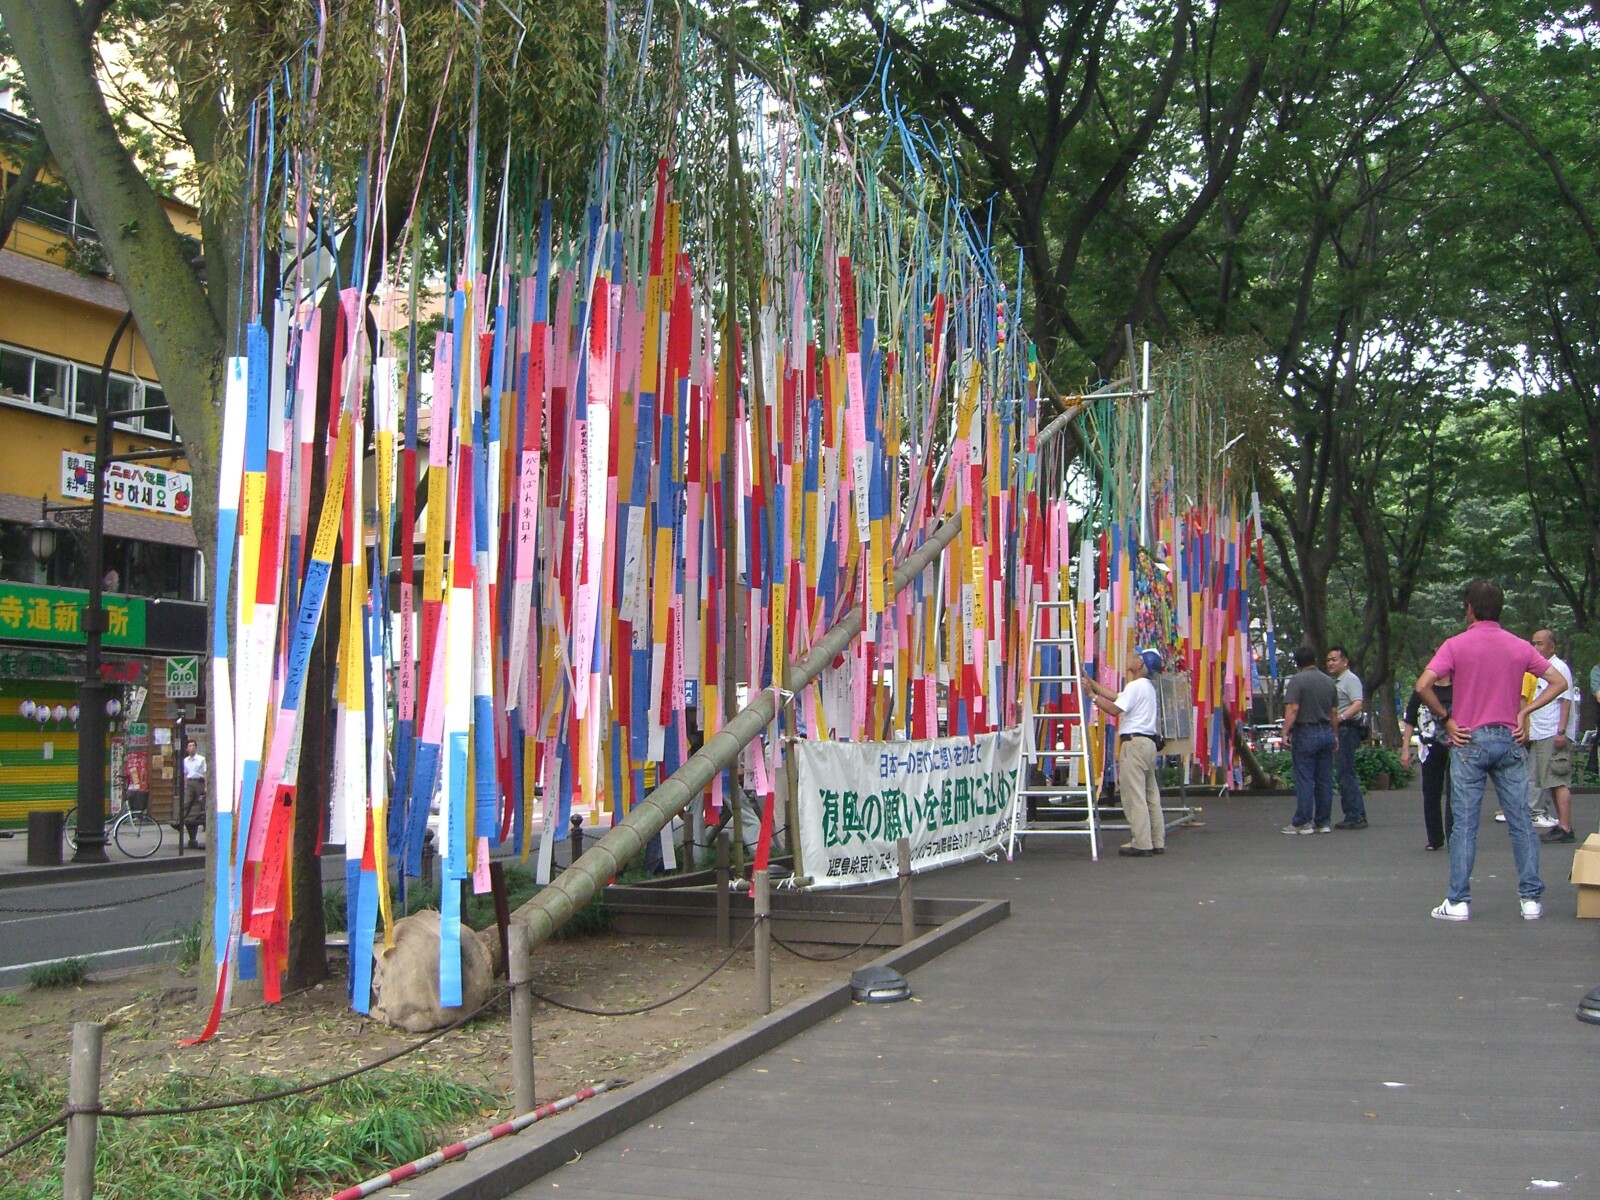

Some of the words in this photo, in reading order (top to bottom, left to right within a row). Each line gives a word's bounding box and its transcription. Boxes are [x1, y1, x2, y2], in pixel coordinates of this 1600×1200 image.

[66, 476, 95, 494] 料理
[520, 456, 539, 544] がんばれ東日本
[0, 595, 129, 637] 寺通新所
